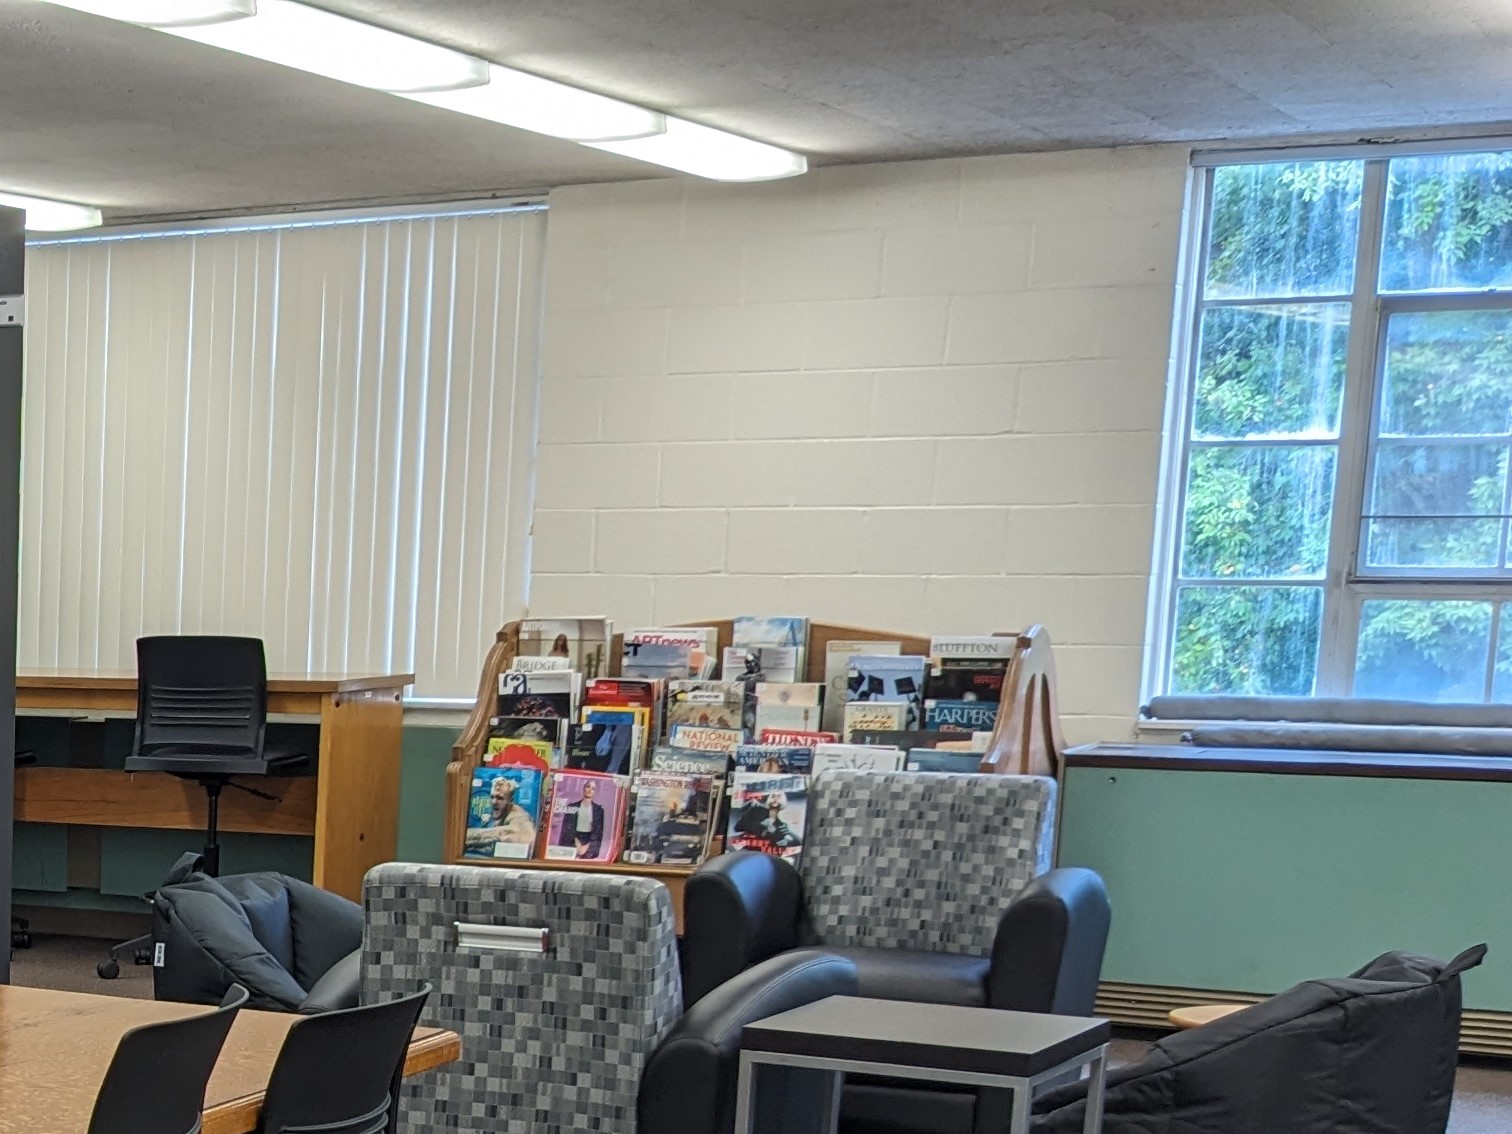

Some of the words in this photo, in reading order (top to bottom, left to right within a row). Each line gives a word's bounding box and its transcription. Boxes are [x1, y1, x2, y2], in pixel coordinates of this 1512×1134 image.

[933, 642, 999, 653] BLUFFTON
[515, 660, 557, 670] BRIDGE
[682, 730, 739, 742] NATIONAL
[688, 740, 731, 751] REVIEW
[653, 756, 710, 774] Science
